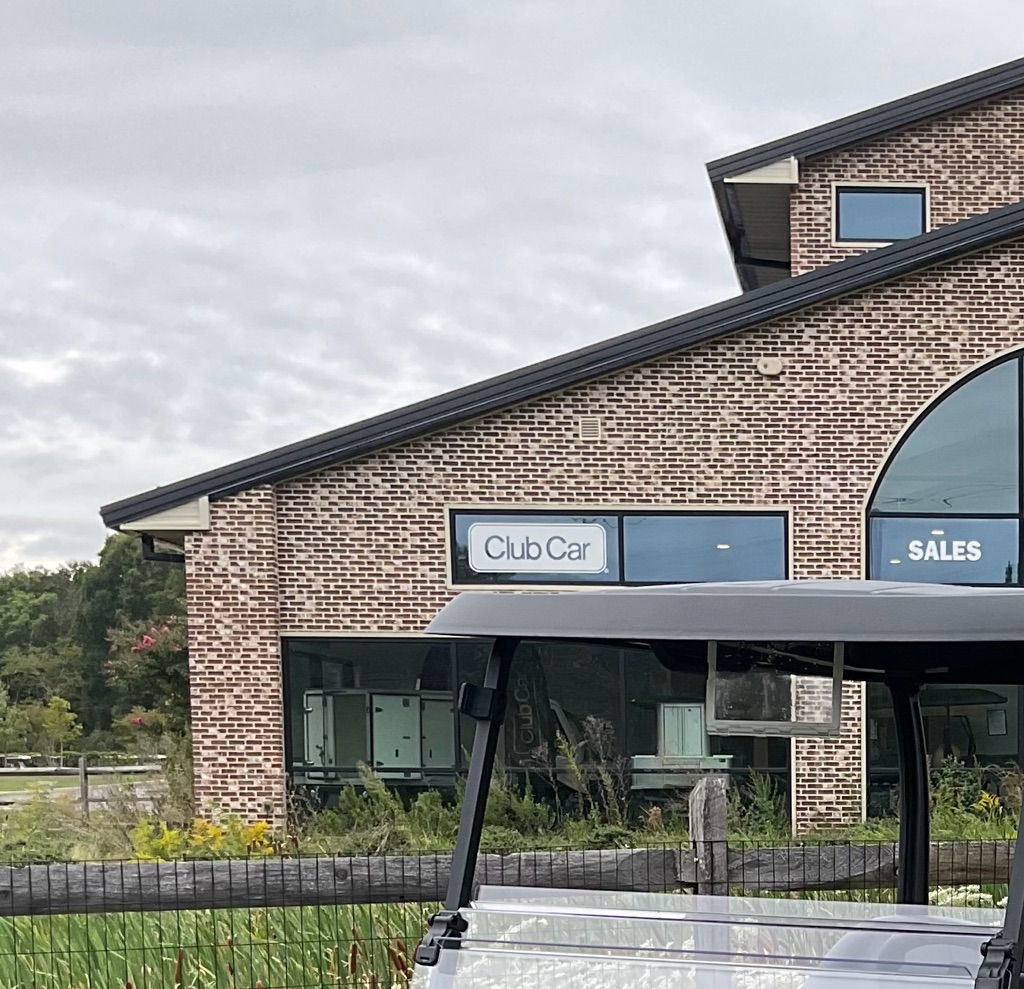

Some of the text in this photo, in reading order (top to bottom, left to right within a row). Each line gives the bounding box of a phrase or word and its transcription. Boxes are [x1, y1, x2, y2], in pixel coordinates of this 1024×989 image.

[485, 535, 590, 560] Club Car
[908, 540, 982, 562] SALES
